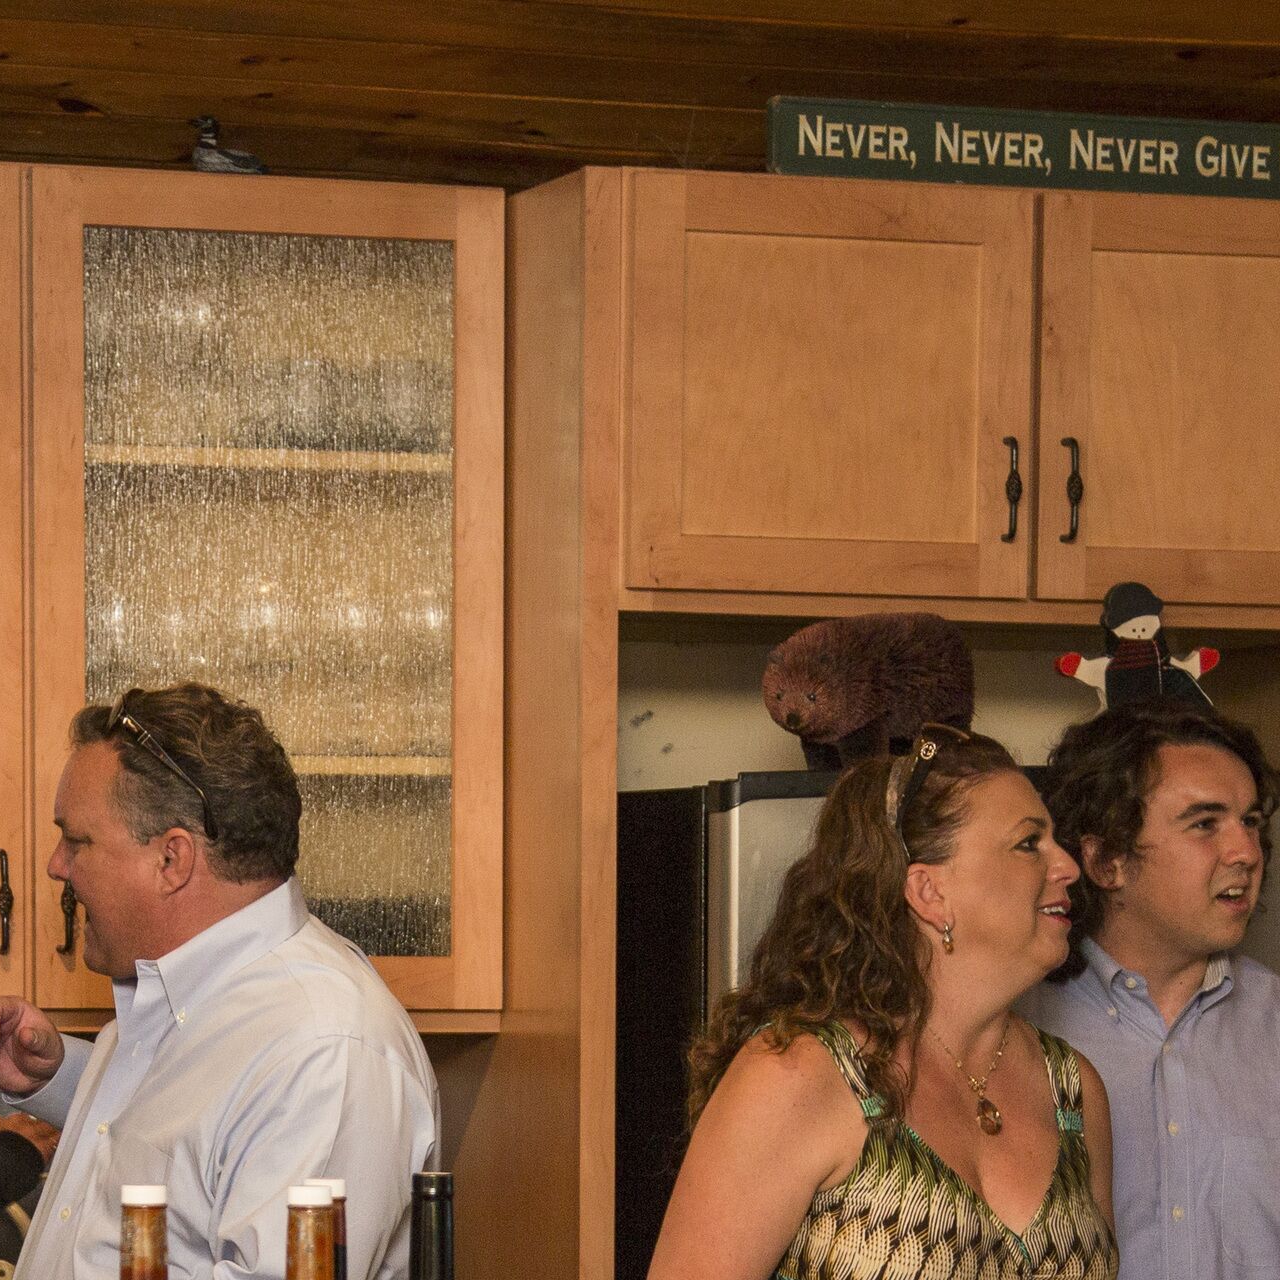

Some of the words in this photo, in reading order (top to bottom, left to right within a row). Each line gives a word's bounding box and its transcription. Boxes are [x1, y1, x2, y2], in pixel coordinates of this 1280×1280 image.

[797, 113, 917, 170] NEVER,
[934, 121, 1053, 177] NEVER,
[1069, 128, 1179, 175] NEVER
[1195, 134, 1271, 181] GIVE
